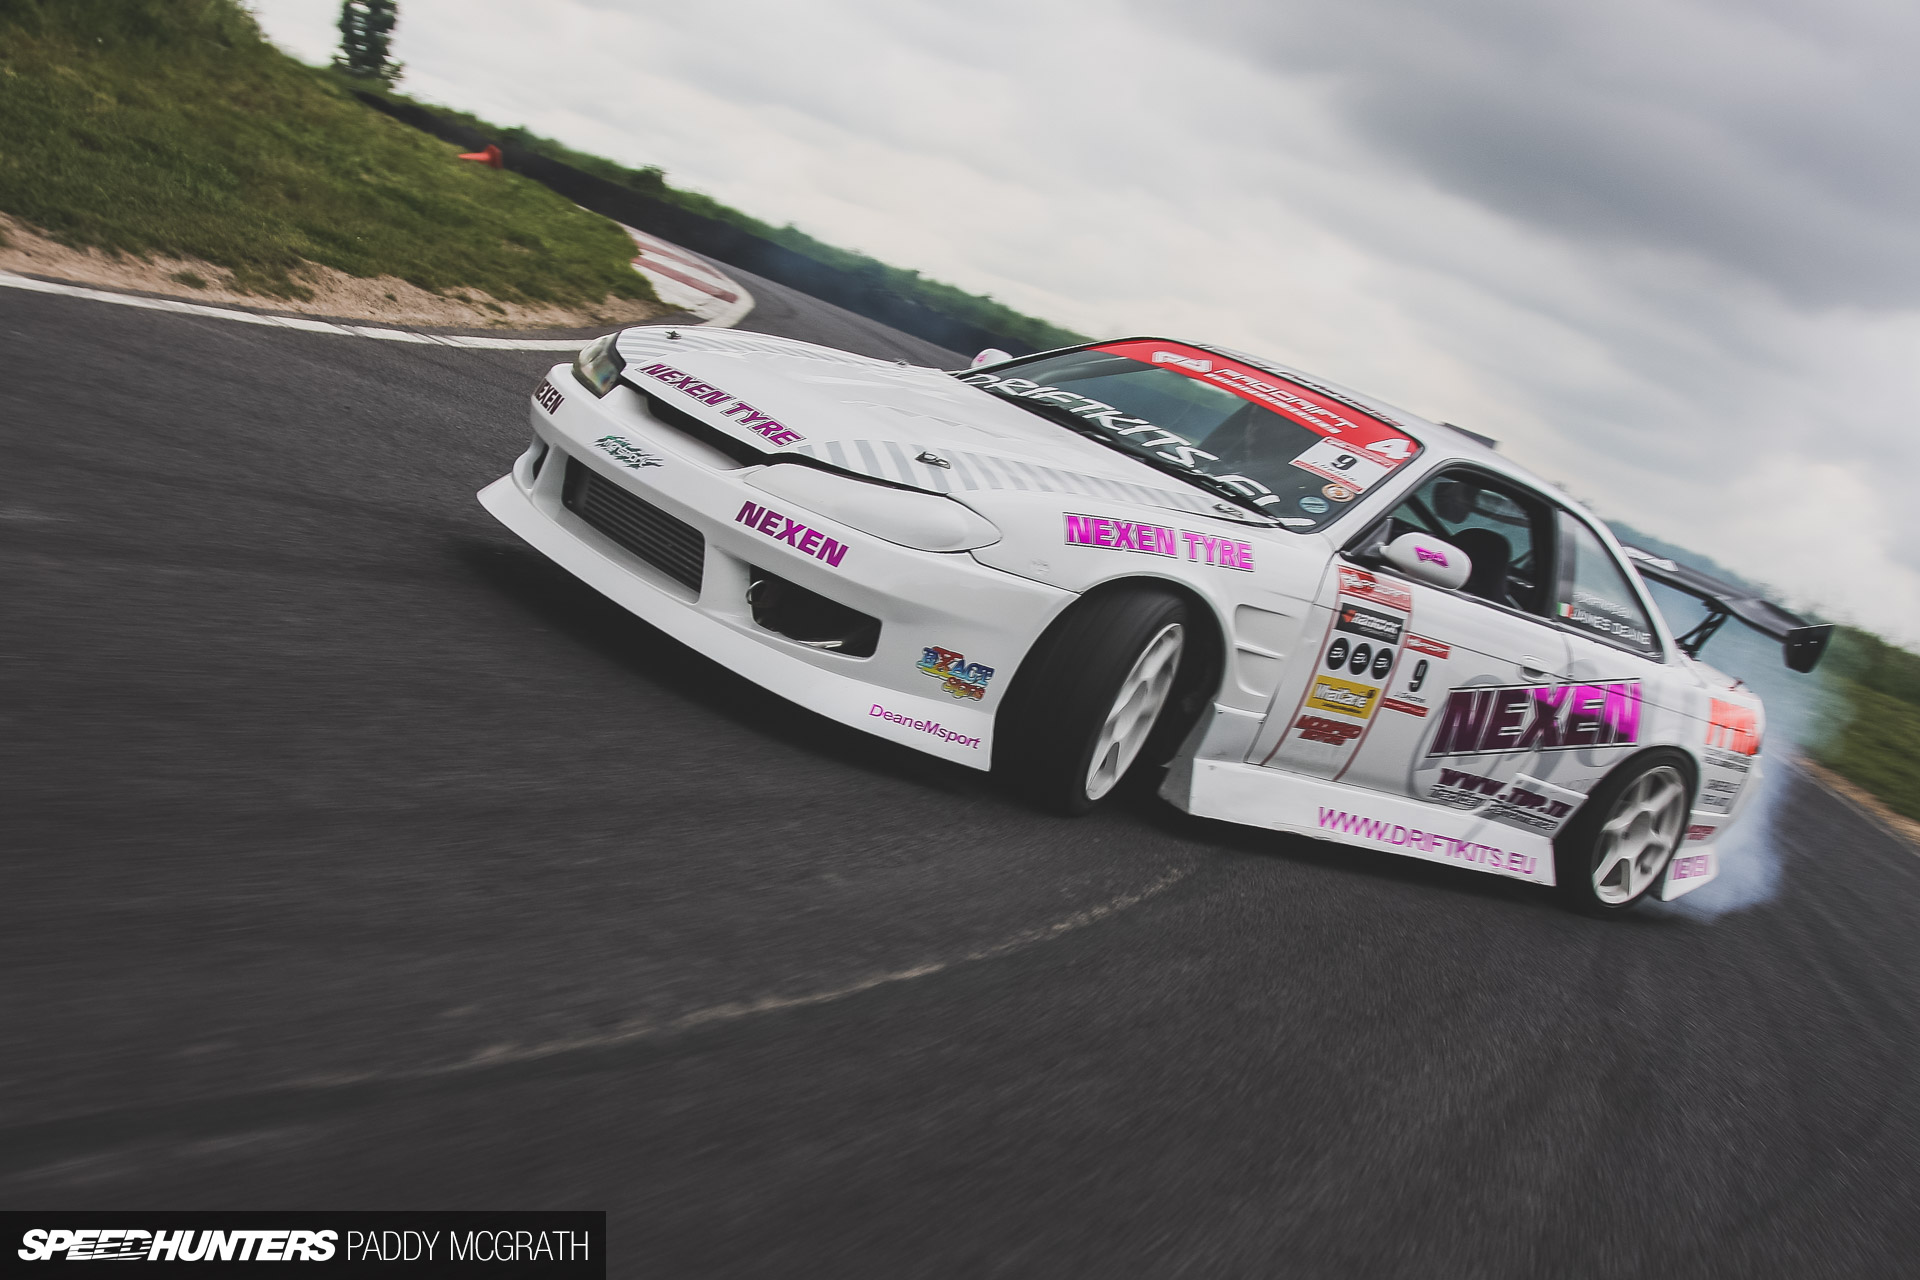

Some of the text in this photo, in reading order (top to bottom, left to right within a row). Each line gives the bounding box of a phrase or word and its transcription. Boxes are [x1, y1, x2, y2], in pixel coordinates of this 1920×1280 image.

[637, 362, 804, 447] NEXEN TYRE
[1331, 455, 1358, 470] 9
[1365, 438, 1412, 460] 4
[735, 500, 850, 568] NEXEN
[1063, 513, 1255, 572] NEXEN TYRE
[915, 645, 996, 688] EXACT
[1408, 659, 1429, 693] 9
[868, 704, 982, 749] DeaneMsport
[1426, 678, 1642, 758] NEXEN
[1318, 806, 1538, 875] WWW.DRIFTKITS.EU
